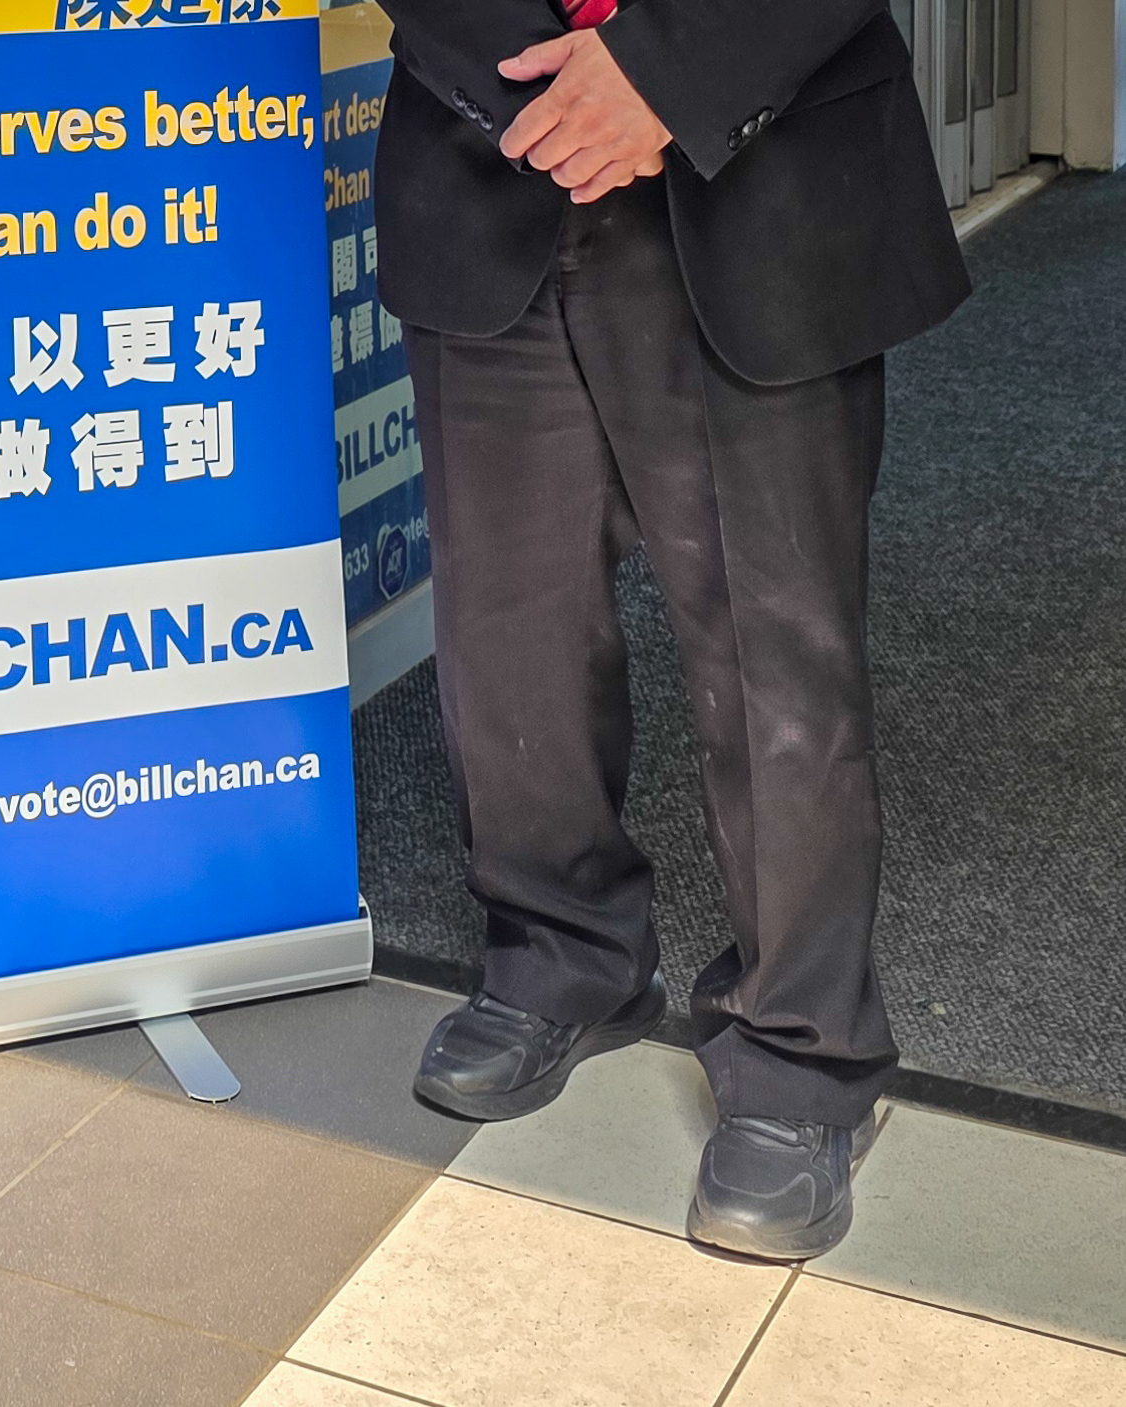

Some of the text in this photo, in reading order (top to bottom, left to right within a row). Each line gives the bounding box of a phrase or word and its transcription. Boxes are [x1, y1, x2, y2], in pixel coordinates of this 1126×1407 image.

[144, 86, 317, 150] better,
[75, 192, 147, 252] do
[164, 185, 219, 245] it!
